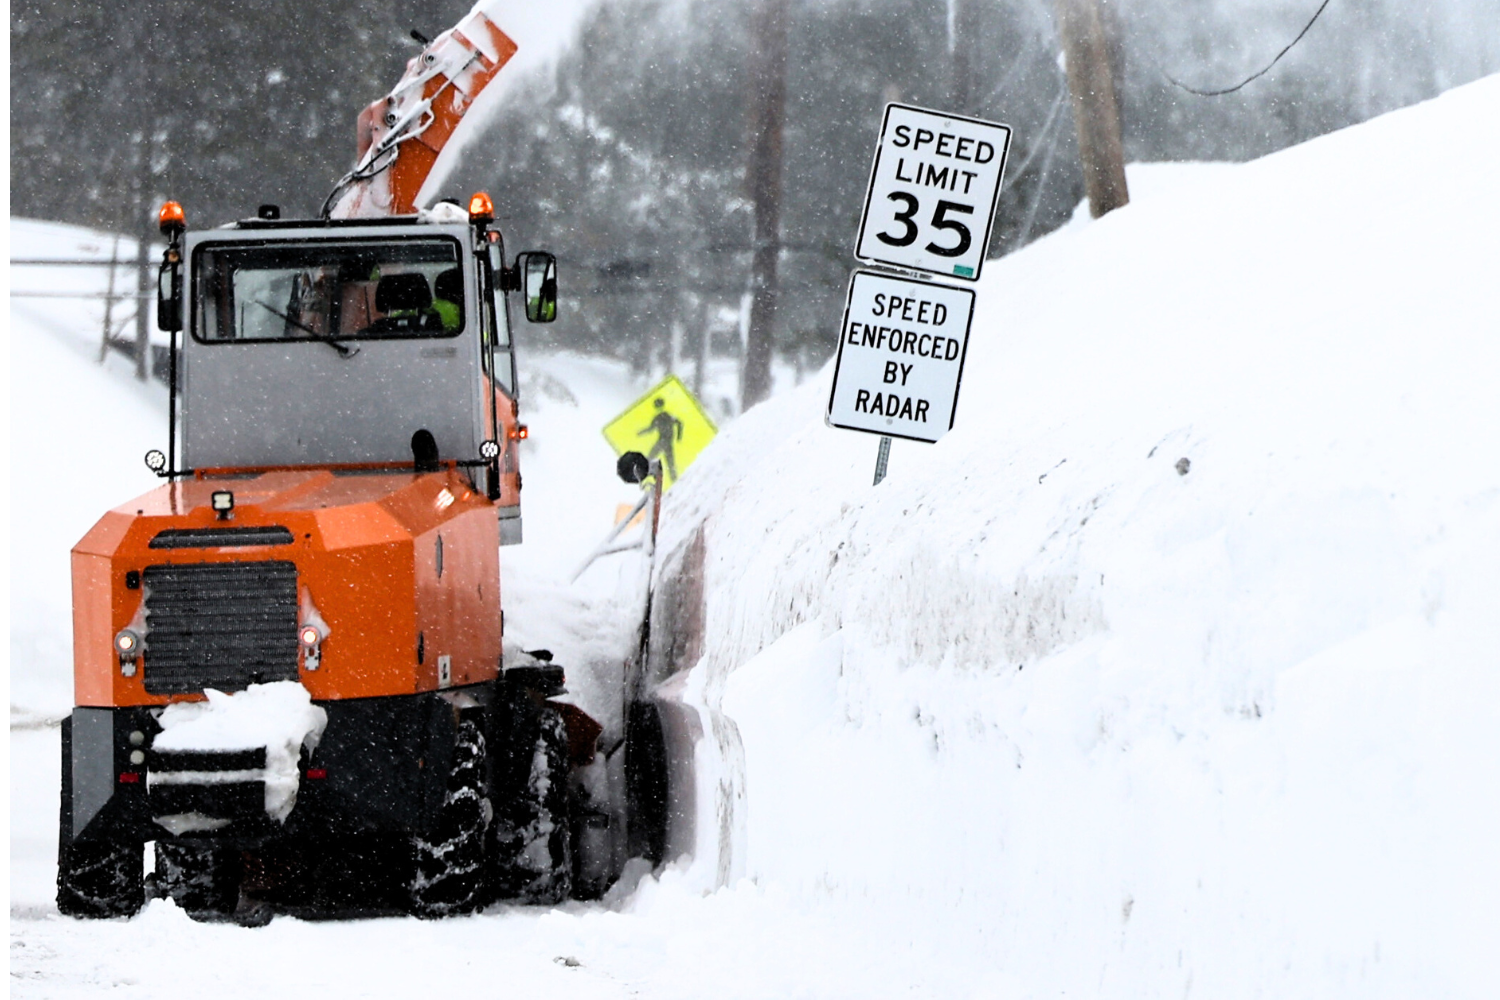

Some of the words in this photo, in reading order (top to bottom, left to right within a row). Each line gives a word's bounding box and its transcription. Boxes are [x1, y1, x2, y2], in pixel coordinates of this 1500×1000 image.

[892, 125, 995, 164] SPEED
[896, 158, 978, 194] LIMIT
[876, 191, 975, 258] 35
[872, 293, 948, 327] SPEED
[848, 322, 960, 362] ENFORCED
[883, 360, 914, 387] BY
[855, 389, 930, 423] RADAR
